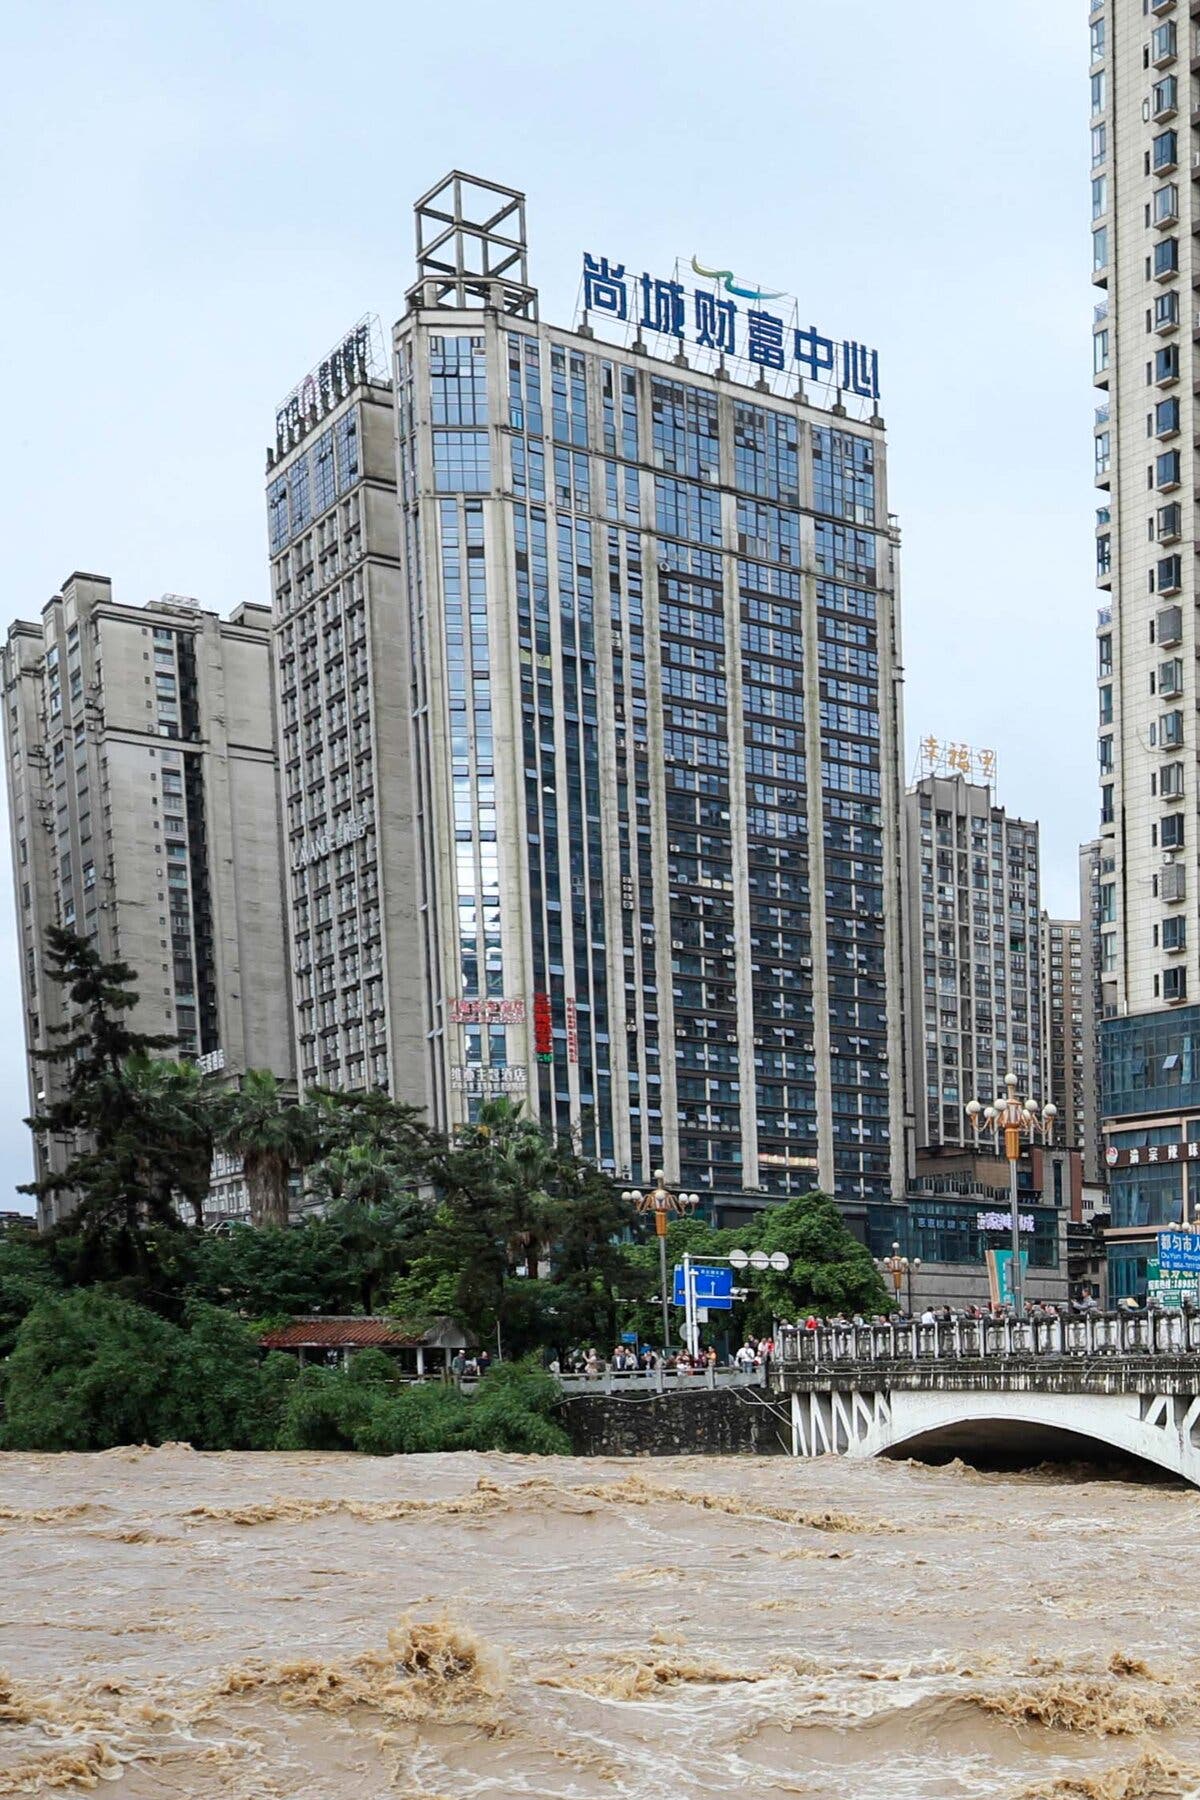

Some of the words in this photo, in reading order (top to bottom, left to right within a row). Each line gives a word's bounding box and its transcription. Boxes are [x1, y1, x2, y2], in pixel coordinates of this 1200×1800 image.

[584, 252, 880, 399] 尚城财富中心
